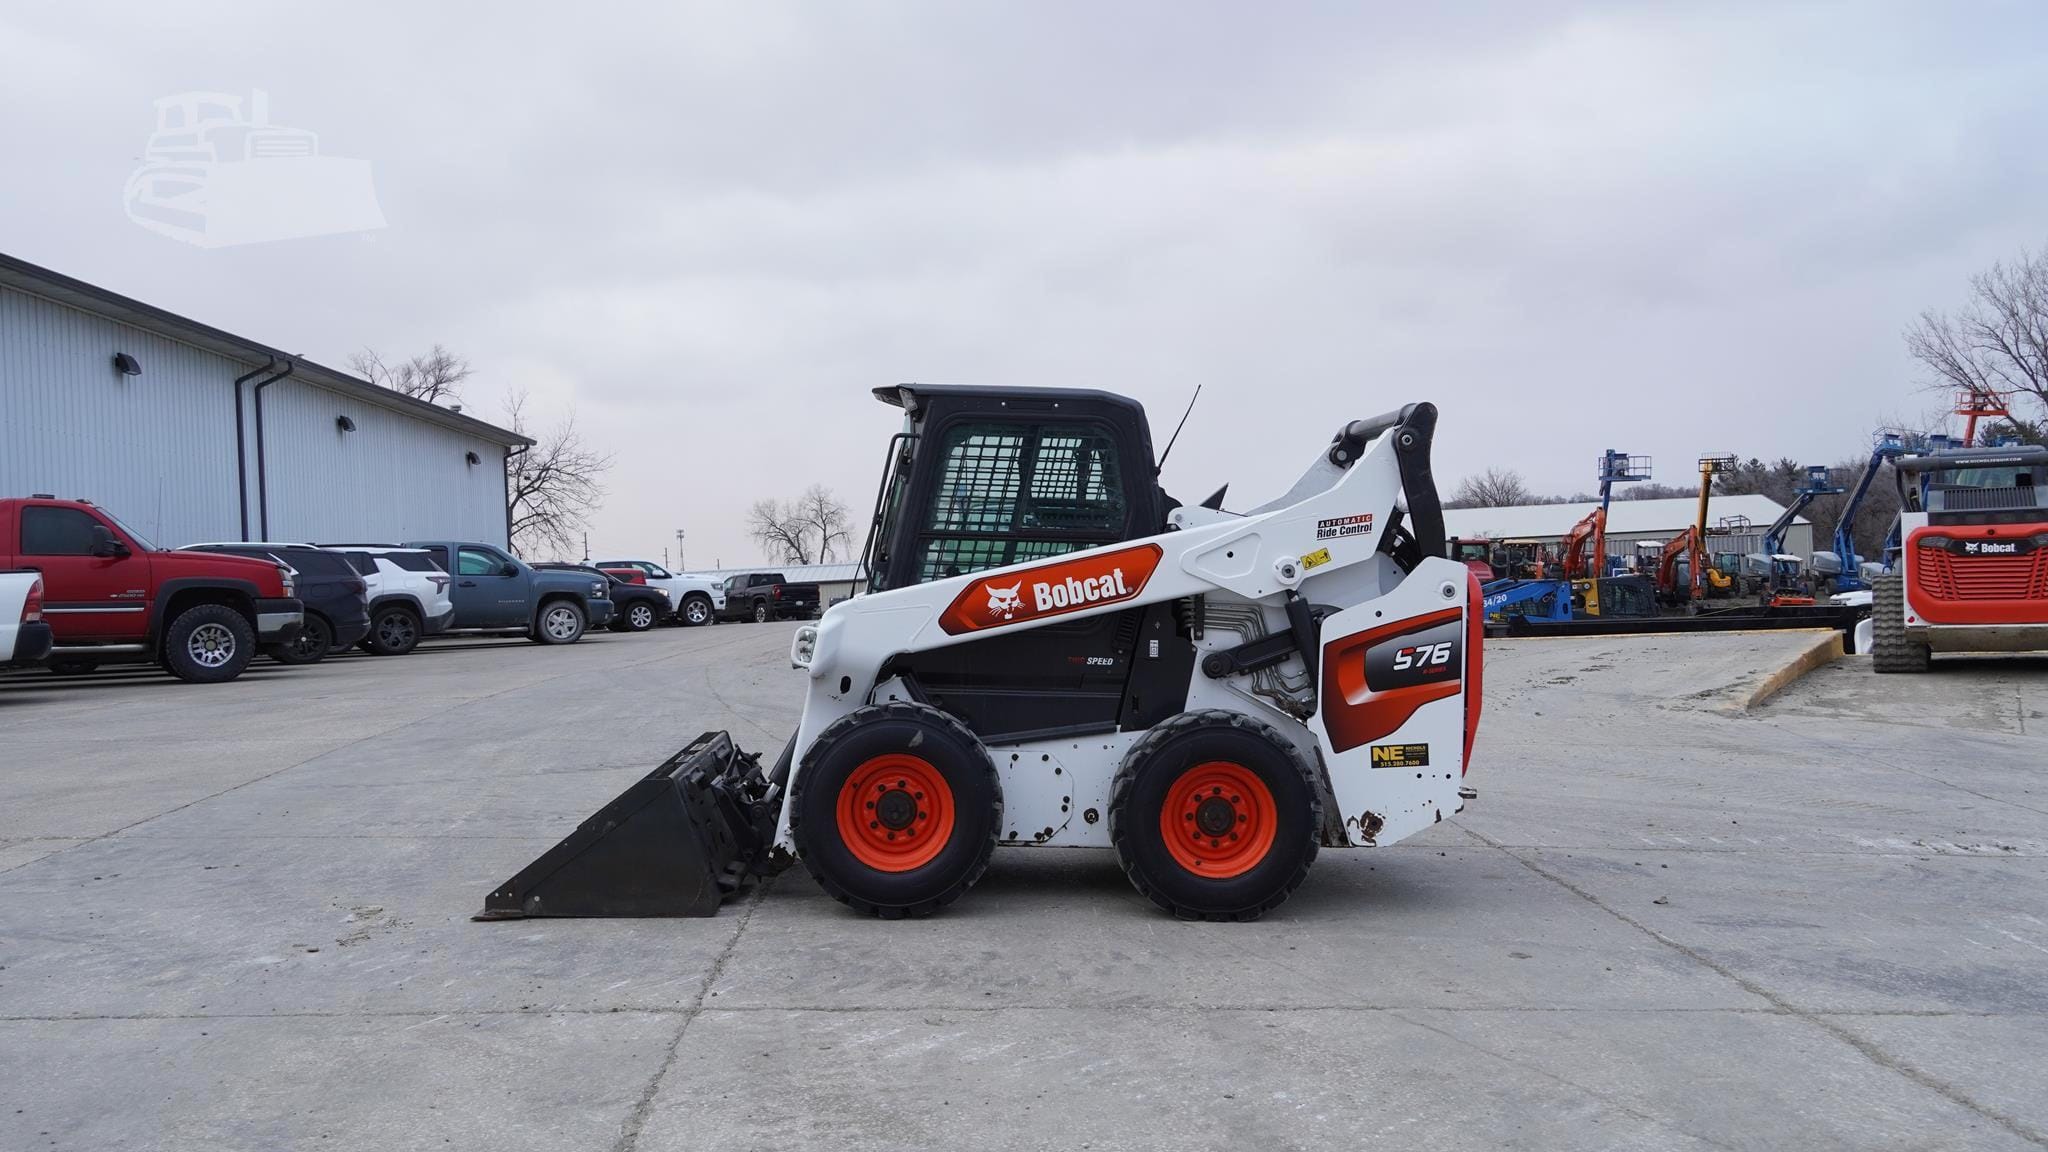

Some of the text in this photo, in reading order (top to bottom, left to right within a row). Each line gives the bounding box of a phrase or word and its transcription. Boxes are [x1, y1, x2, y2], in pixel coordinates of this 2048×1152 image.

[1320, 515, 1371, 528] AUTOMATIC
[1317, 523, 1372, 539] Ride Control
[1981, 543, 2015, 553] Bobcat
[1033, 568, 1127, 612] Bobcat
[1086, 656, 1113, 666] SPEED
[1393, 642, 1452, 671] S76
[1372, 746, 1404, 762] NE
